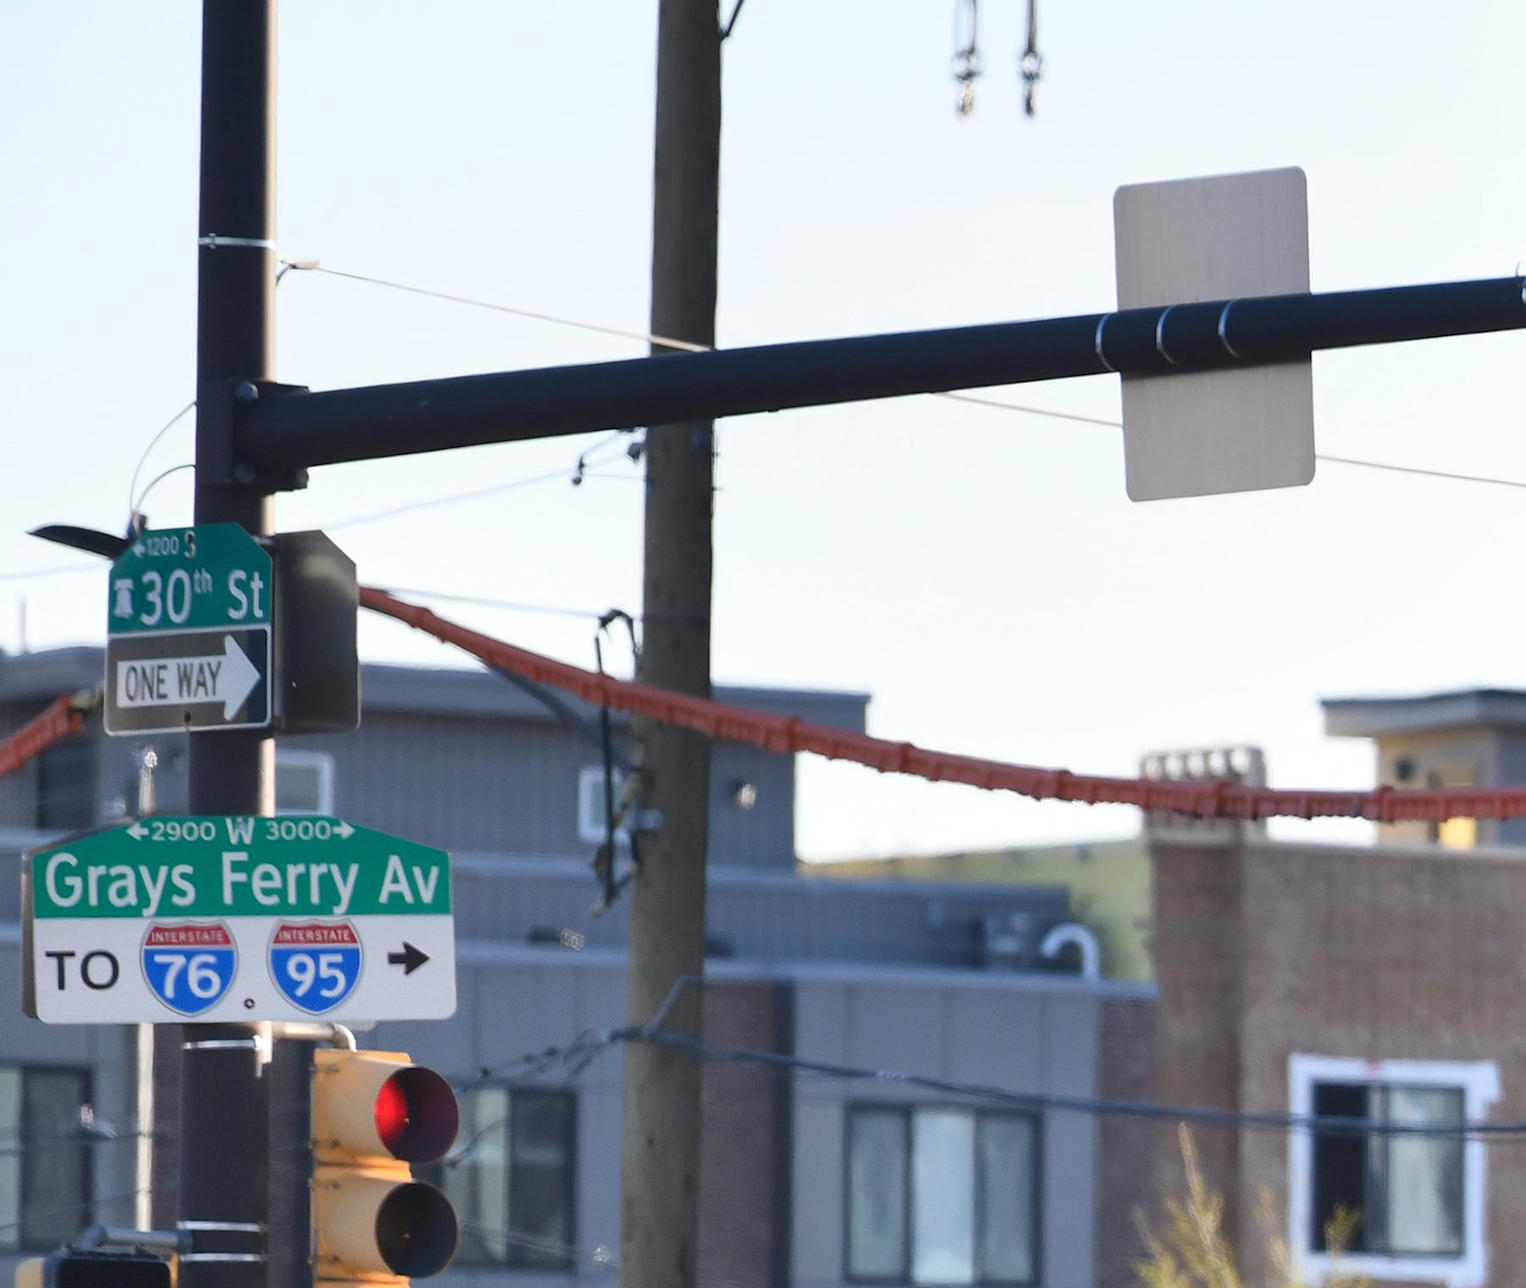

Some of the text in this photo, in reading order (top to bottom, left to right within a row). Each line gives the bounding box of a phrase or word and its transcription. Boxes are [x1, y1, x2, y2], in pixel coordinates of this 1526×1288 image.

[146, 531, 196, 558] 1200 S
[140, 568, 264, 625] 30th St
[125, 661, 222, 702] ONE WAY
[151, 817, 331, 845] 2900 W 3000
[44, 851, 439, 917] Grays Ferry Av
[151, 930, 224, 943] INTERSTATE
[277, 929, 350, 942] INTERSTATE
[45, 950, 347, 999] TO 76 95
